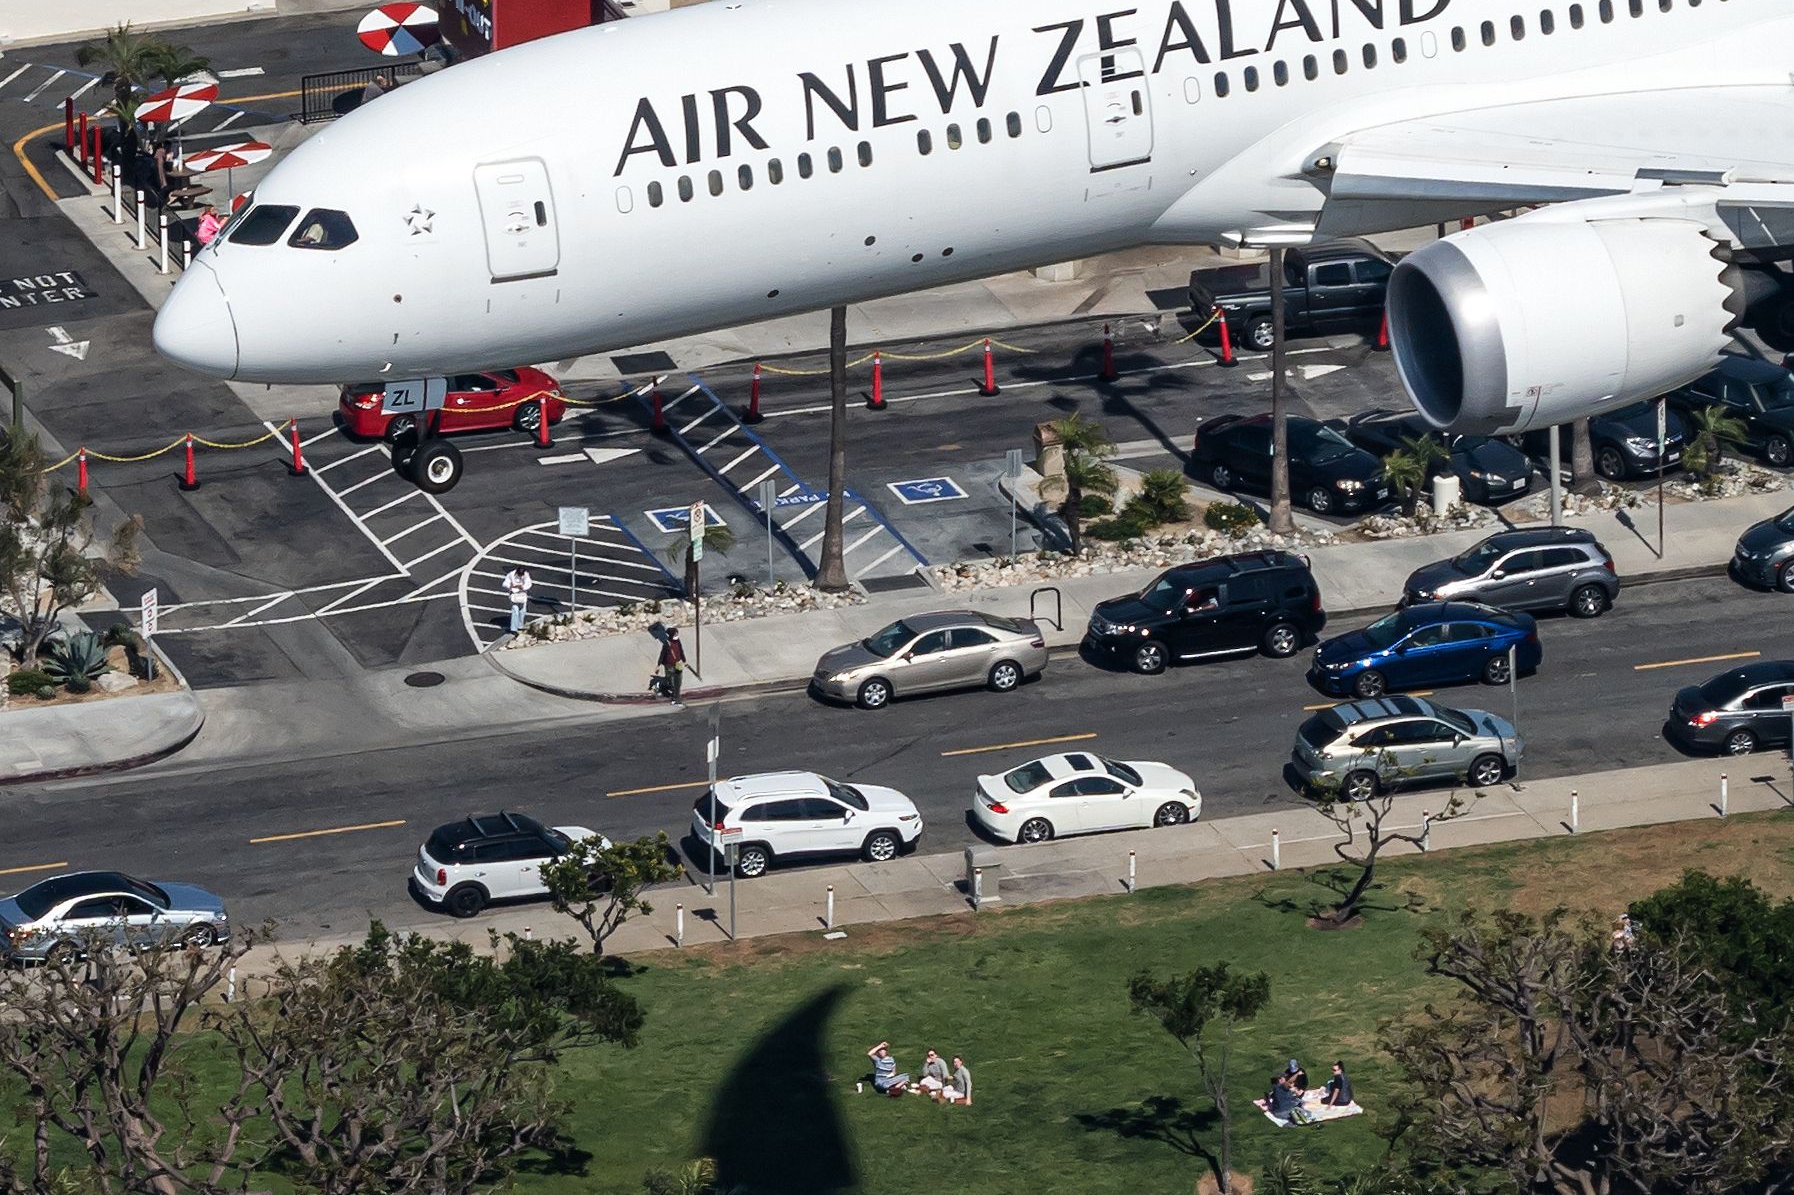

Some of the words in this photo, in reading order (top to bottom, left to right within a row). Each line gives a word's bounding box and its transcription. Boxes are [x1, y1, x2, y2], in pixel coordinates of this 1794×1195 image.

[614, 85, 768, 177] AIR
[797, 35, 1000, 141] NEW
[12, 272, 75, 291] NOT
[391, 389, 415, 407] ZL
